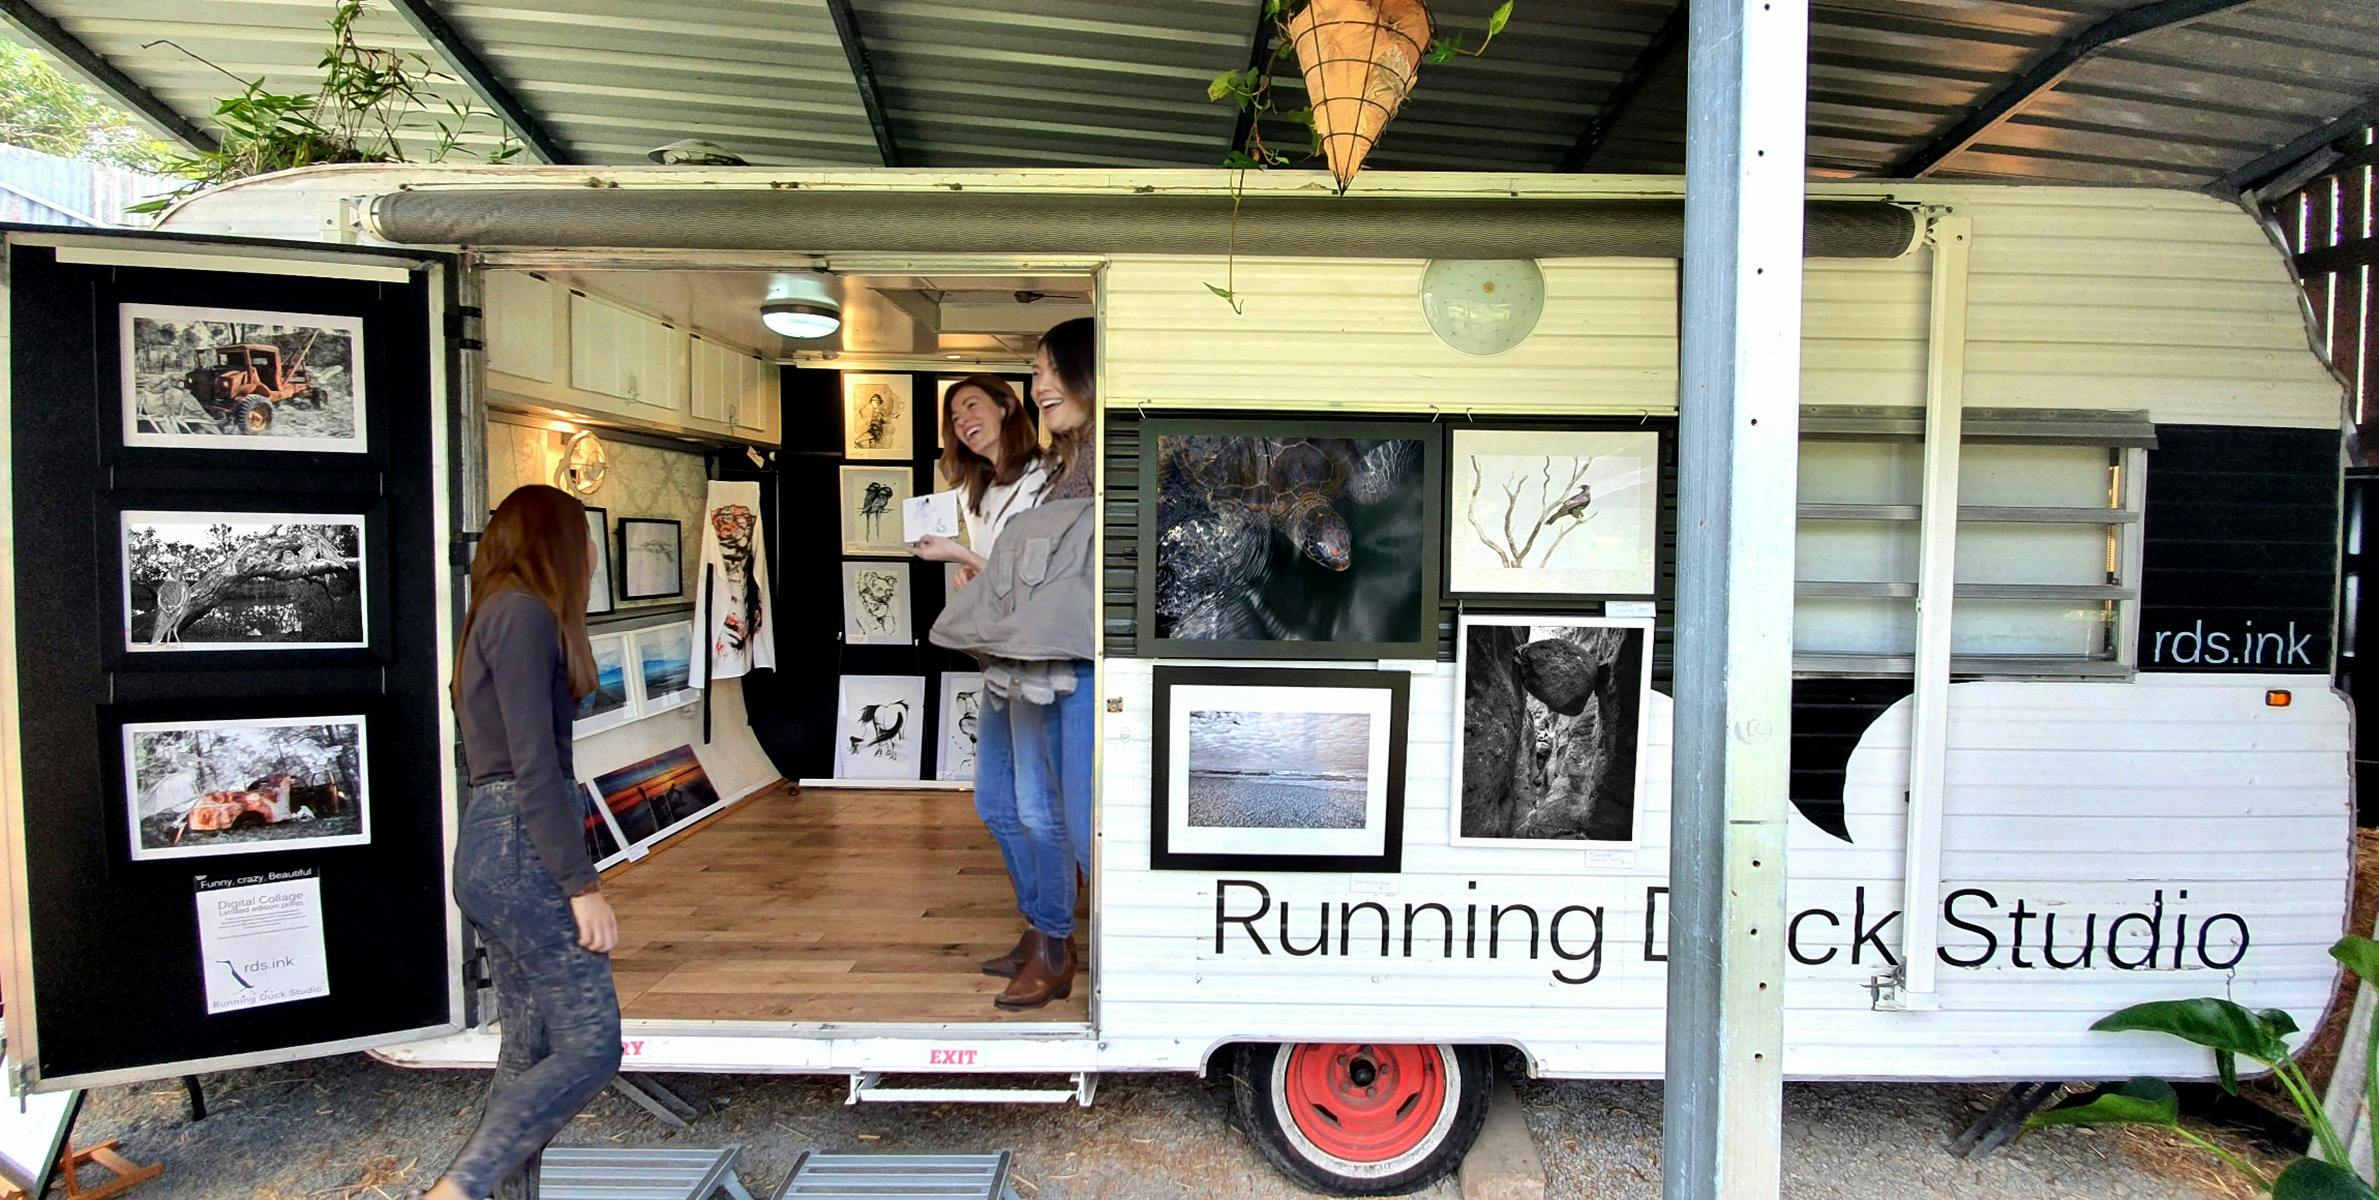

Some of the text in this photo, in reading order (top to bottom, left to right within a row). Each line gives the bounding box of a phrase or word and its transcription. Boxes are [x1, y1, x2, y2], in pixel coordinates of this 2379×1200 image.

[2154, 619, 2312, 665] rds.ink
[268, 867, 312, 880] Beautiful
[217, 892, 304, 911] Digital Collage
[1215, 879, 1604, 985] Running
[1937, 889, 2250, 970] Studio
[244, 957, 295, 973] rds.ink
[212, 986, 322, 1009] Running Duck Studio
[929, 1049, 978, 1065] EXIT
